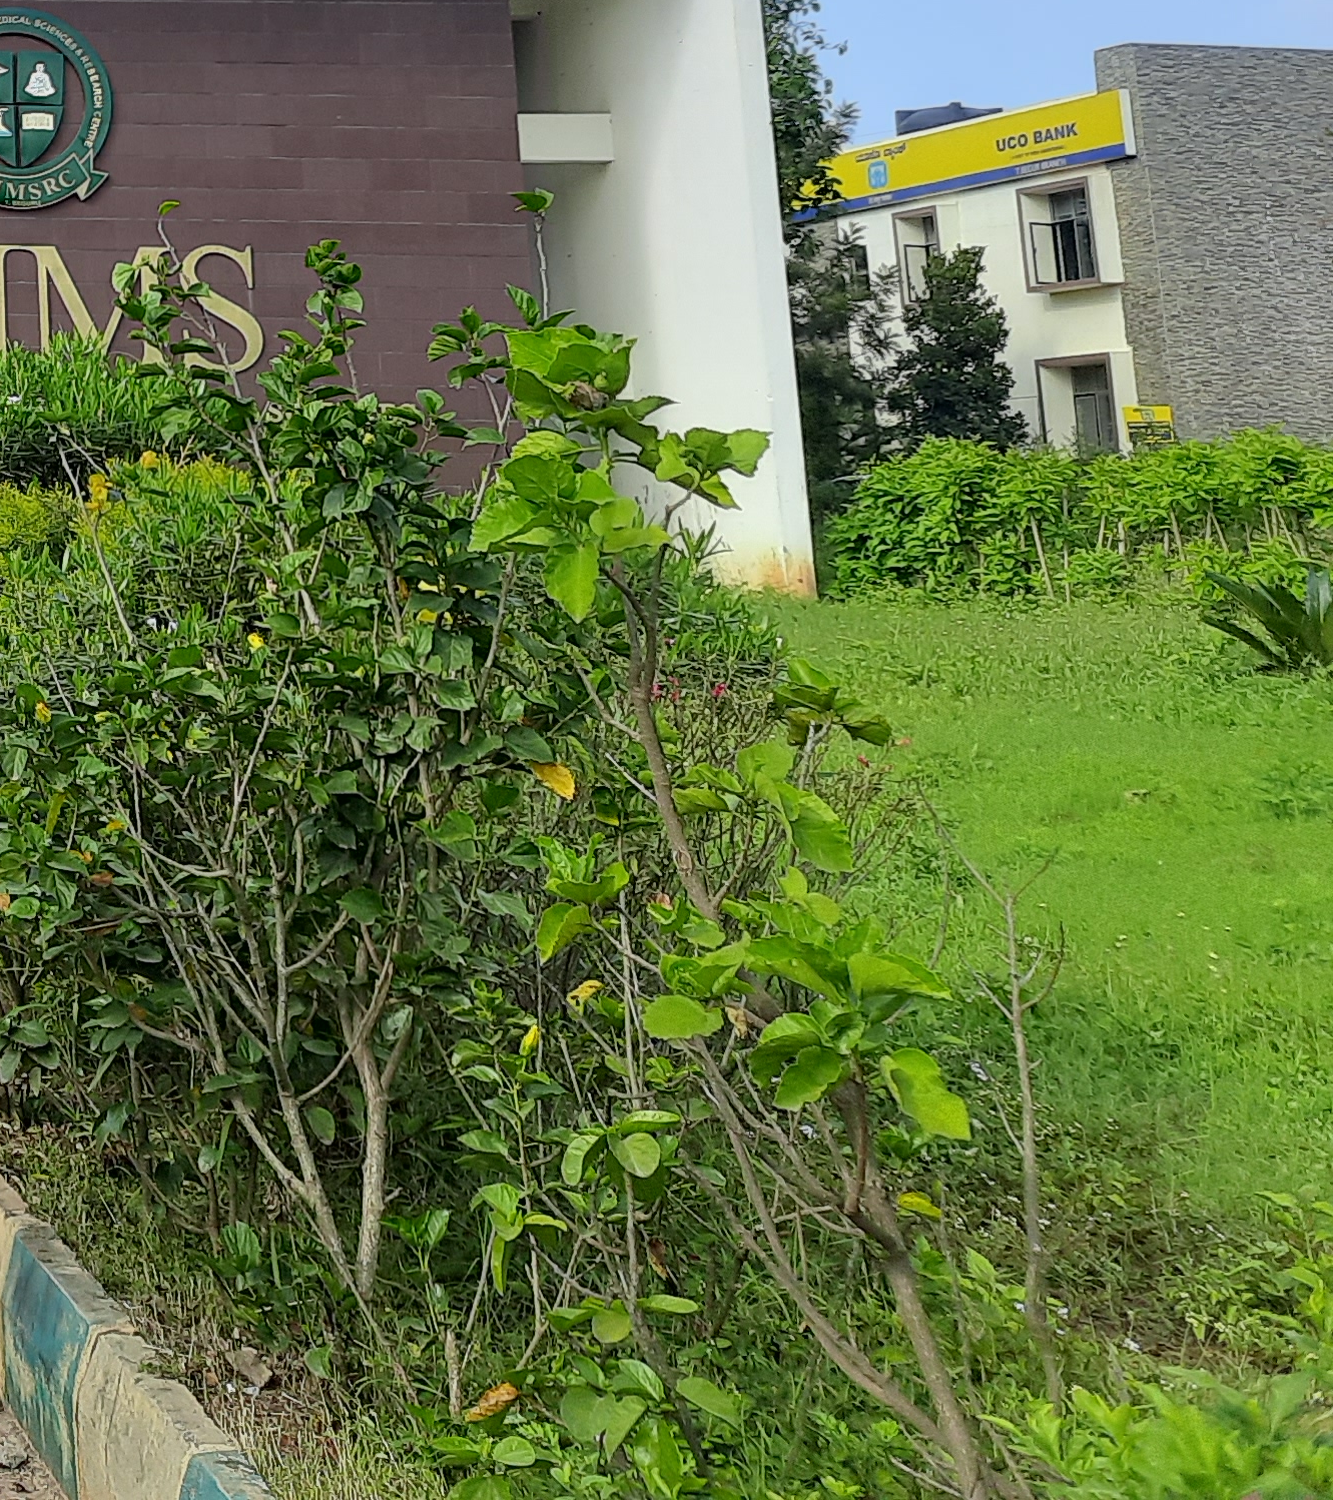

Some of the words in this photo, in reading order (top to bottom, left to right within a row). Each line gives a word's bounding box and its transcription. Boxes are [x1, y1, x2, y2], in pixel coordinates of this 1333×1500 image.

[34, 18, 78, 51] SCIENCES
[80, 55, 103, 108] RESEARCH
[84, 110, 102, 148] CENTRE
[996, 134, 1028, 152] UCO
[1033, 122, 1078, 144] BANK
